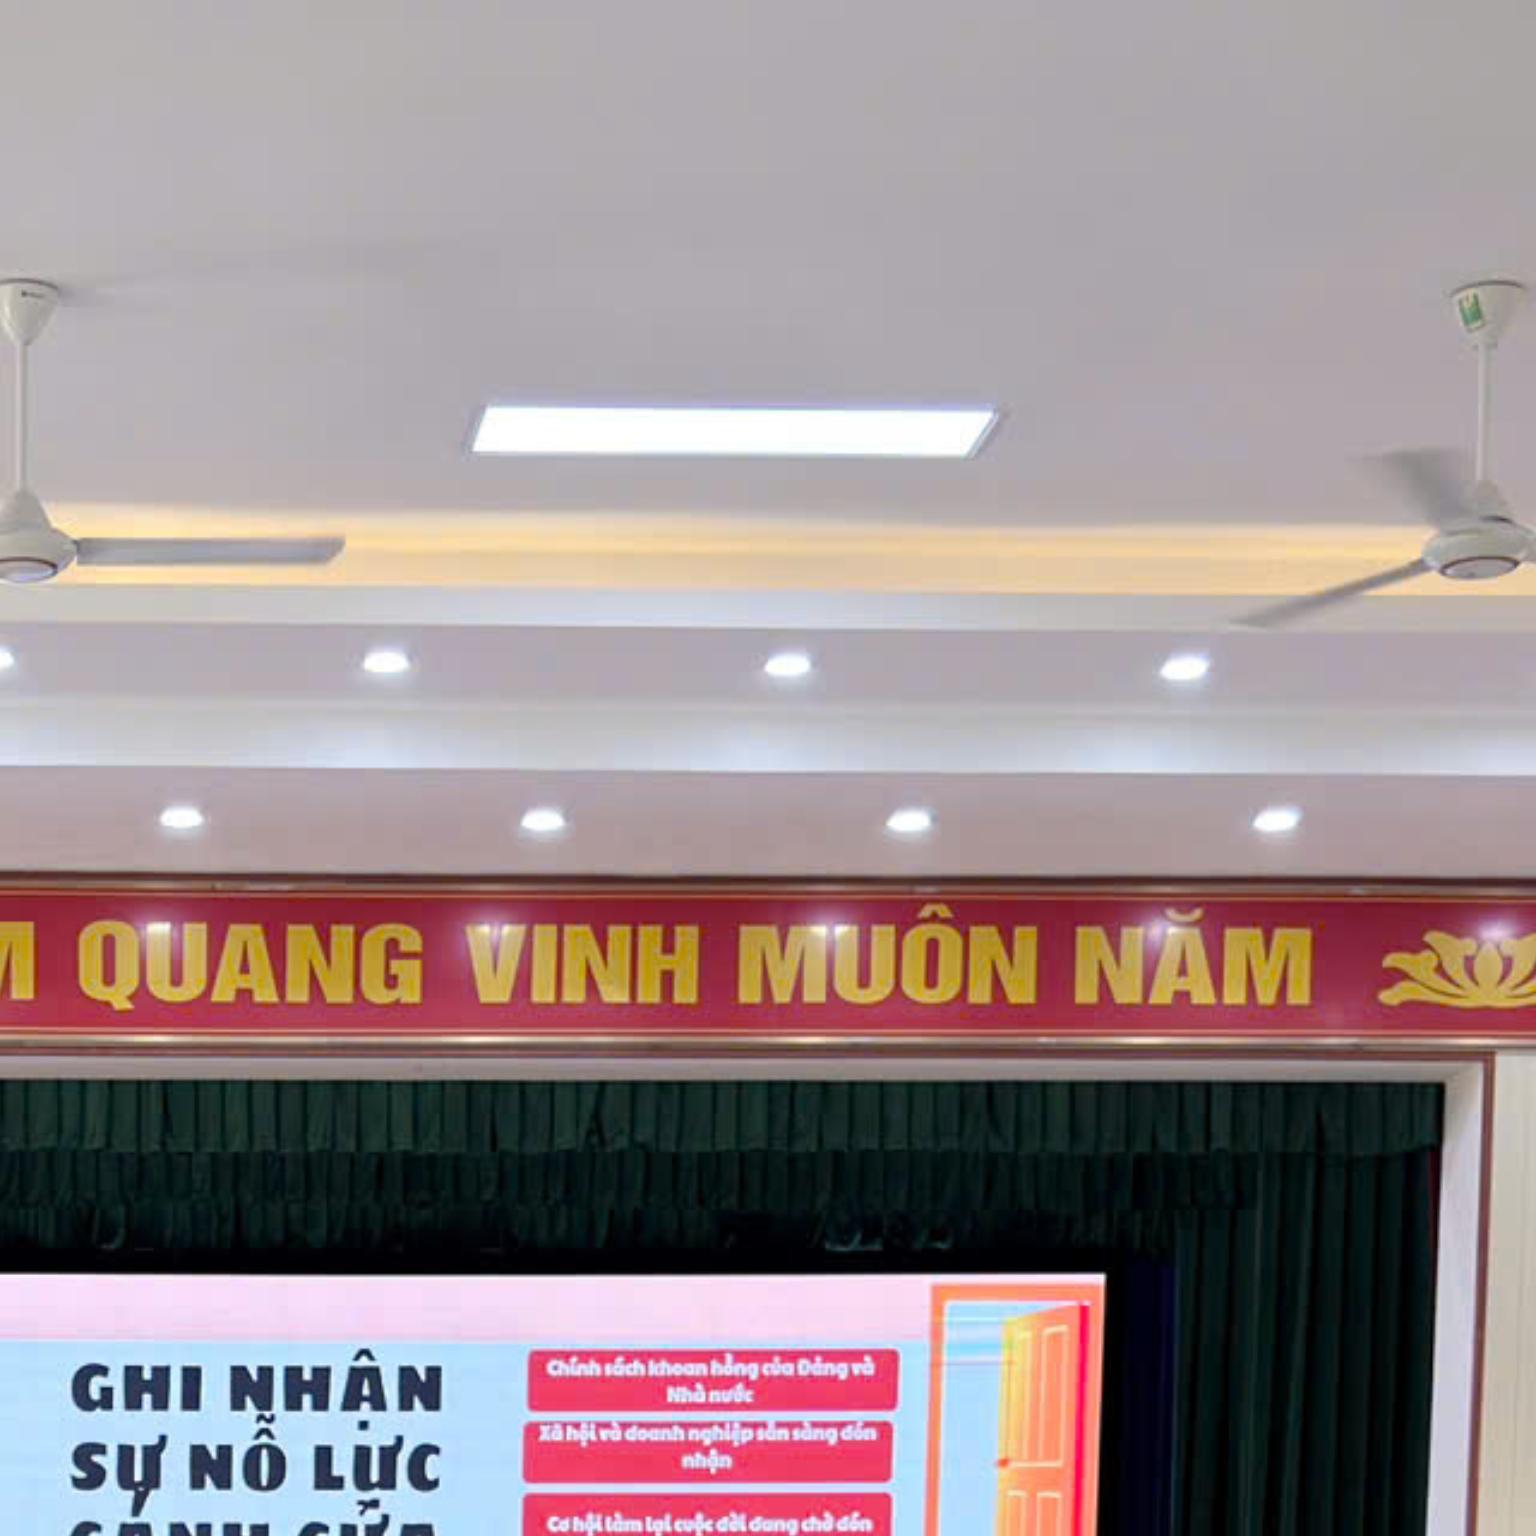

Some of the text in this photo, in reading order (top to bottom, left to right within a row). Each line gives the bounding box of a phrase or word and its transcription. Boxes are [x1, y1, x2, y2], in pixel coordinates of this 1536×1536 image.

[78, 920, 424, 1004] QUANG
[468, 922, 700, 1002] VINH
[740, 902, 1038, 1003] MUÔN
[1075, 912, 1313, 1003] NĂM
[70, 1348, 442, 1431] GHI NHẬN
[70, 1413, 440, 1507] SỰ NỖ LỰC
